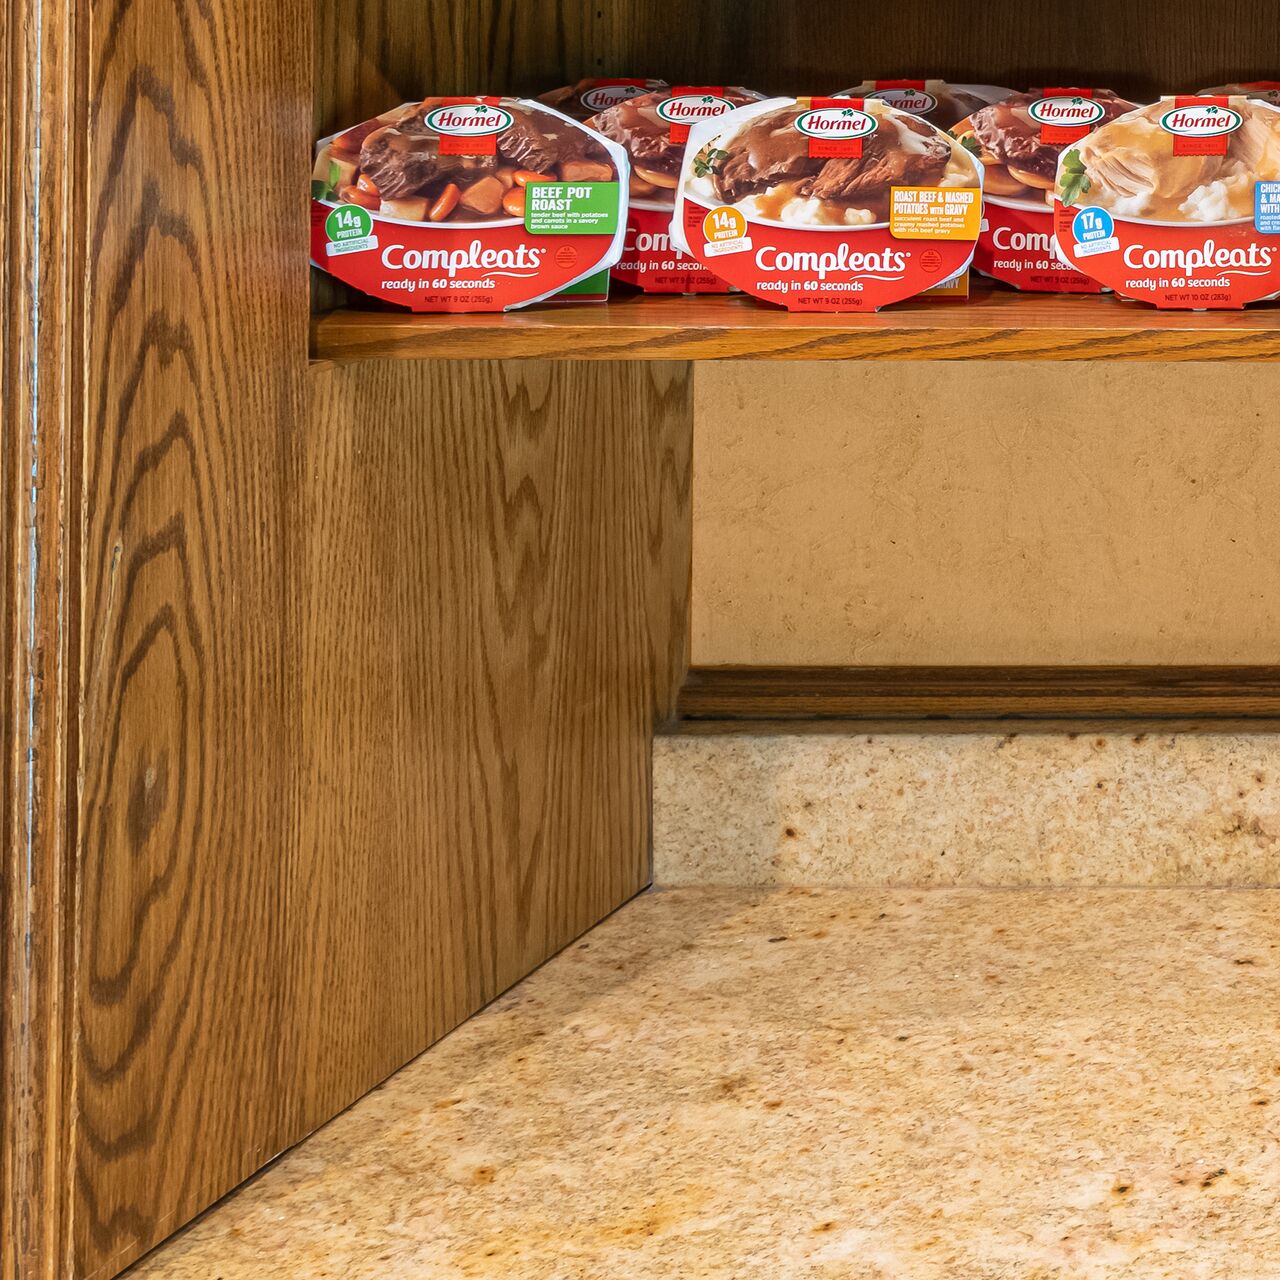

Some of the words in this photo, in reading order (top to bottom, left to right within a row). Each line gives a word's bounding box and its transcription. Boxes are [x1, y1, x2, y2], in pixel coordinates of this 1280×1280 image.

[438, 110, 501, 129] Hormel
[807, 114, 866, 132] Hormel
[1172, 112, 1232, 131] Hormel
[532, 187, 563, 198] BEEF
[567, 187, 591, 198] POT
[532, 199, 571, 210] ROAST
[335, 210, 361, 227] 14g
[1082, 212, 1102, 228] 17g
[382, 240, 541, 277] Compleats
[755, 243, 906, 279] Compleats
[1123, 240, 1272, 277] Compleats
[382, 279, 416, 292] ready
[418, 279, 430, 289] in
[432, 279, 447, 288] 60
[449, 279, 495, 289] seconds
[1125, 278, 1156, 290] ready
[1158, 278, 1169, 288] in
[1171, 278, 1185, 288] 60
[1187, 277, 1230, 288] seconds
